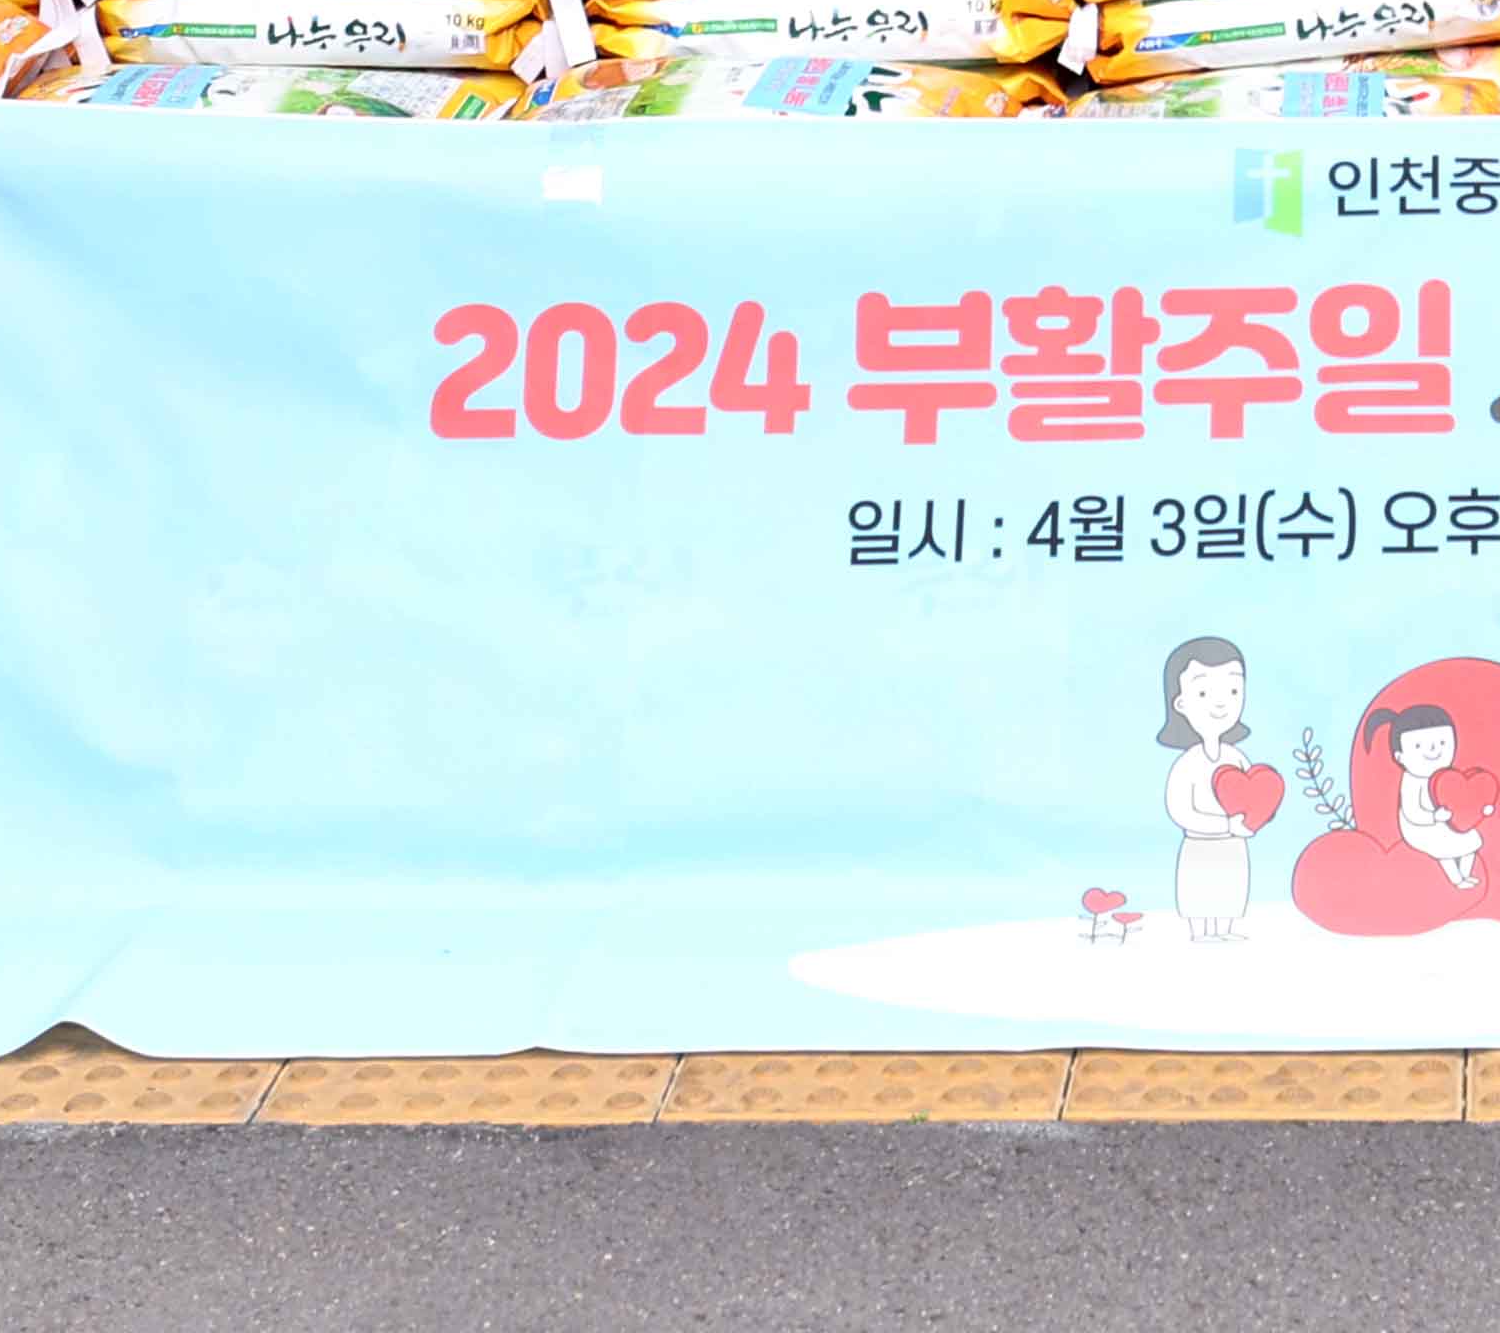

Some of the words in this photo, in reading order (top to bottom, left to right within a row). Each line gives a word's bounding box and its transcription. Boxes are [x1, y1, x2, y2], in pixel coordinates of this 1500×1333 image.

[433, 303, 809, 438] 2024
[849, 281, 1453, 443] 부활주일
[848, 499, 965, 565] 일시
[1026, 495, 1124, 562] 4월
[1150, 487, 1356, 562] 3일(수)
